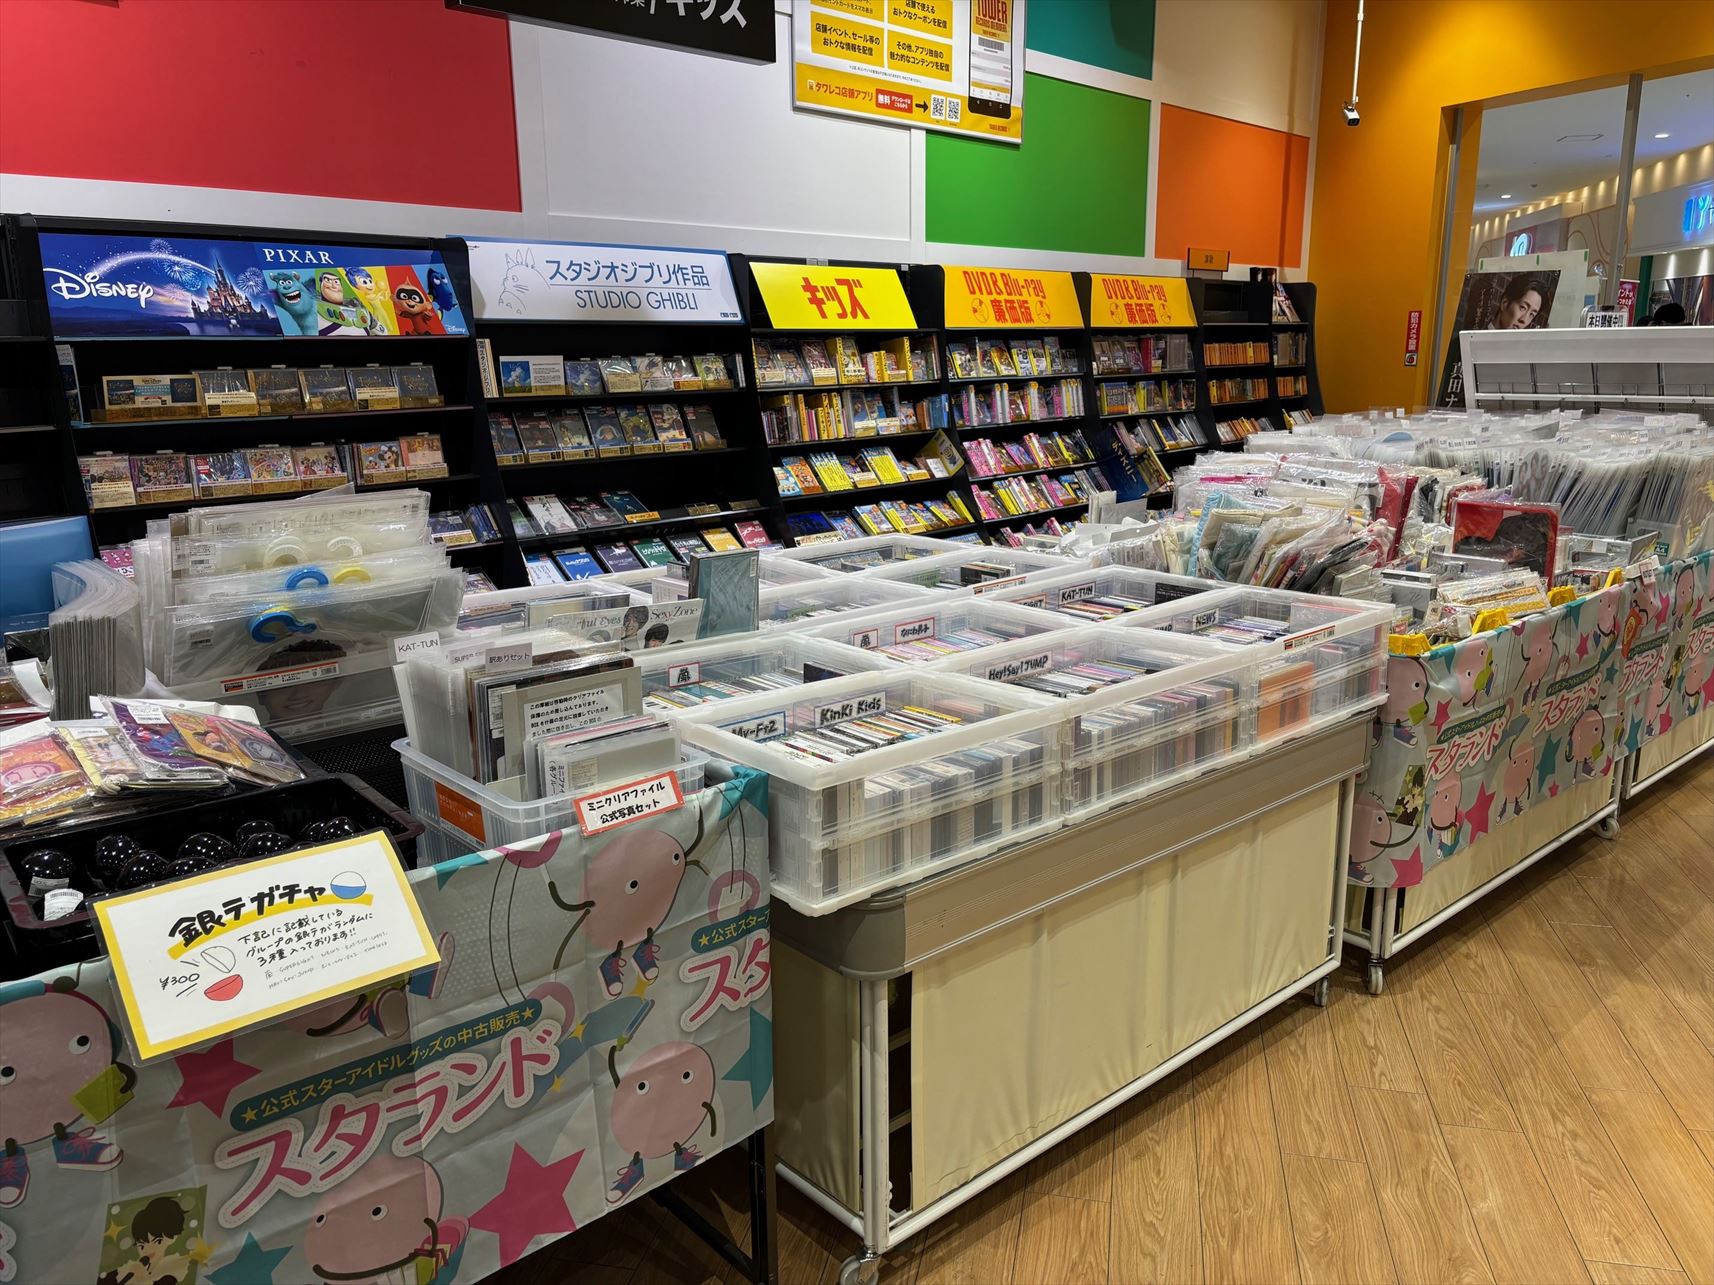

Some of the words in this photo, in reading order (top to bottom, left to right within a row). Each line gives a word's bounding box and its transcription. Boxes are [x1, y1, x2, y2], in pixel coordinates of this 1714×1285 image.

[822, 38, 874, 56] おトクな情報を配信
[815, 82, 874, 101] タワレコ店舗アプリ
[263, 248, 334, 265] PIXAR
[545, 259, 710, 287] スタジオジブリ作品
[574, 290, 642, 310] STUDIO
[647, 291, 699, 311] GHIBLI
[801, 276, 871, 320] キッズ
[1061, 585, 1094, 602] KAT-TUN
[1196, 610, 1218, 626] NEWS
[398, 639, 439, 653] KAT-TUN
[488, 652, 531, 664] 訳ありセット
[677, 668, 691, 684] 嵐
[819, 703, 853, 723] KinKi
[857, 697, 882, 714] Kids
[587, 782, 666, 812] ミニクリアファイル
[600, 799, 661, 824] 公式写真セット
[168, 883, 327, 947] 銀テガチャ
[160, 973, 200, 991] ¥300
[260, 1009, 522, 1118] 公式スターアイドルグッズの中古販売
[226, 1026, 553, 1218] スタランド
